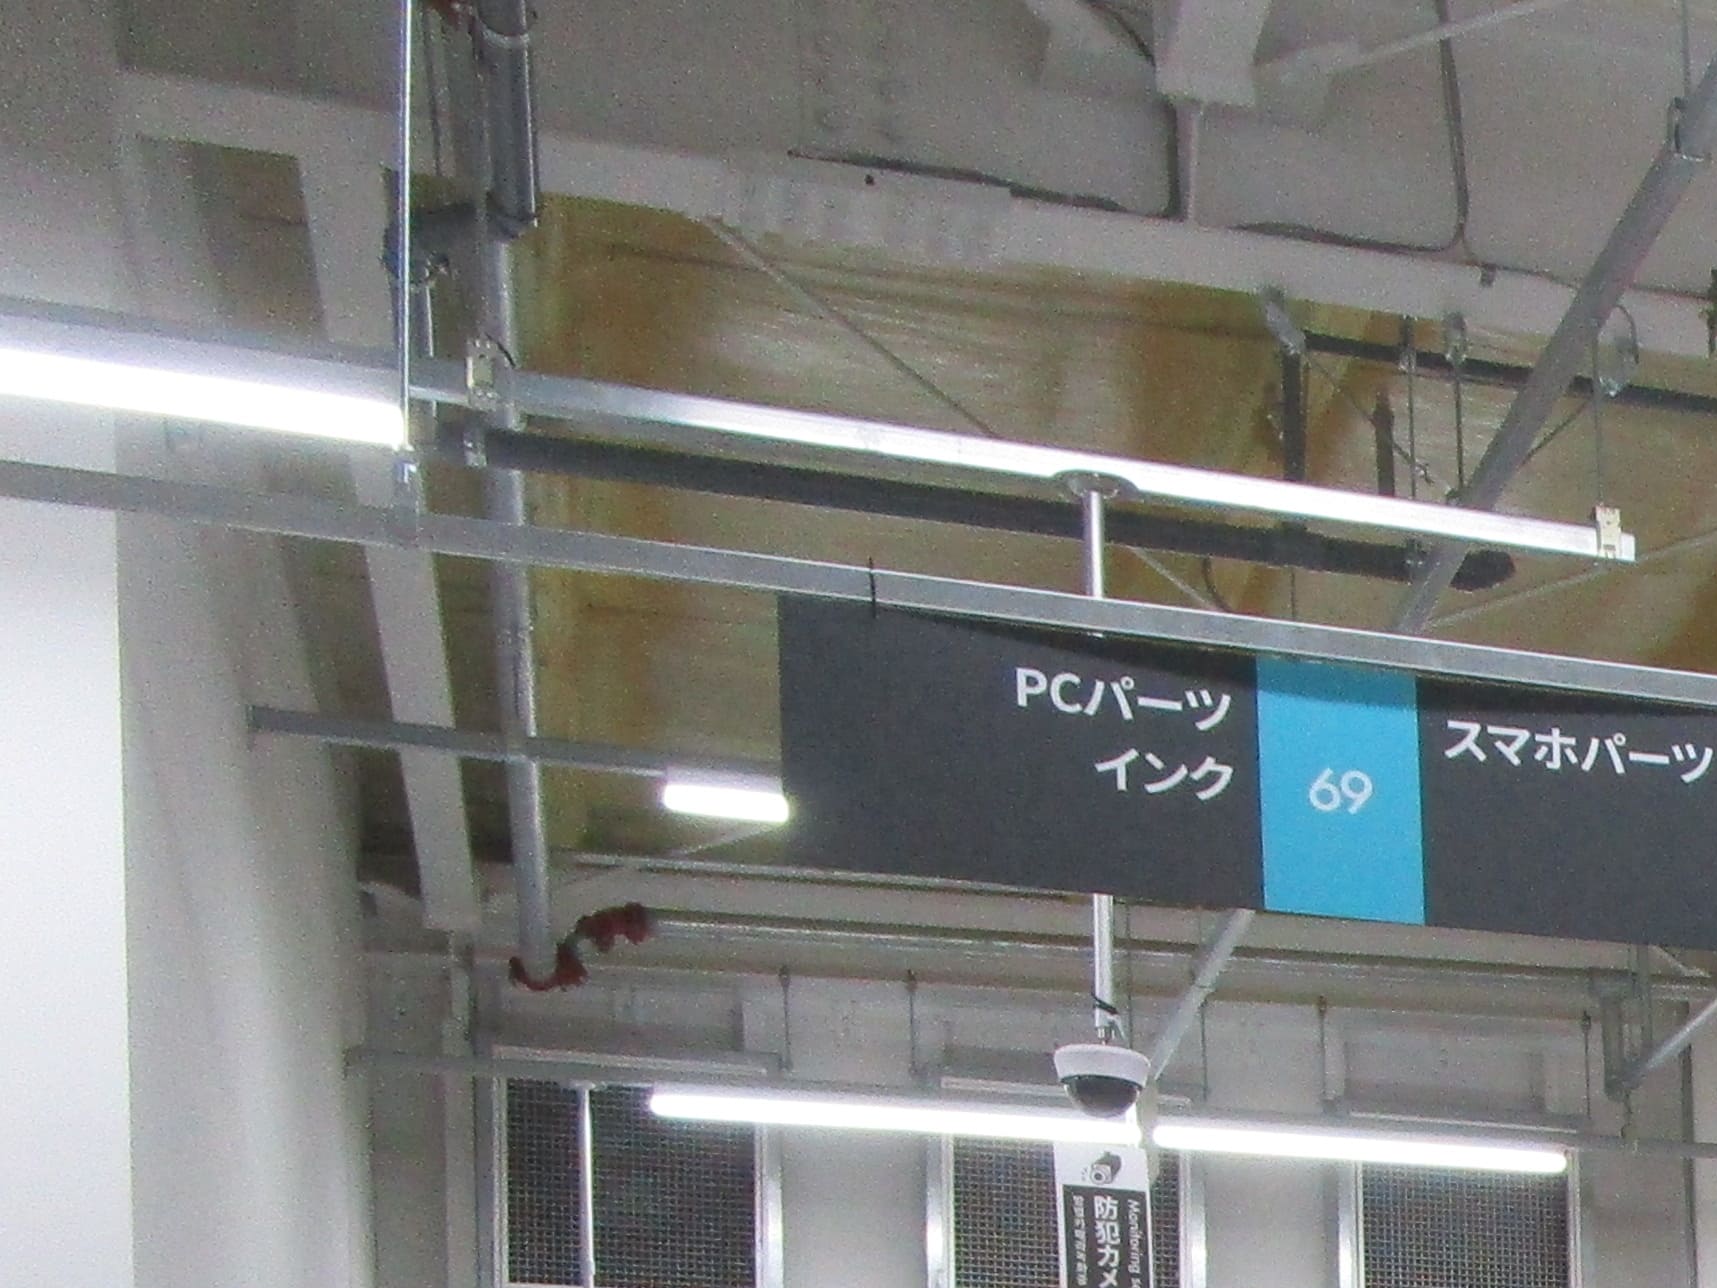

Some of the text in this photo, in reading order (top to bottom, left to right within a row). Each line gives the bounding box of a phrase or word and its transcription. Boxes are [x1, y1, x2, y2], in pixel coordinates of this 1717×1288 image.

[1015, 665, 1232, 733] PCパーツ
[1093, 748, 1235, 800] インク
[1444, 717, 1715, 784] スマホパーツ
[1308, 765, 1374, 815] 69
